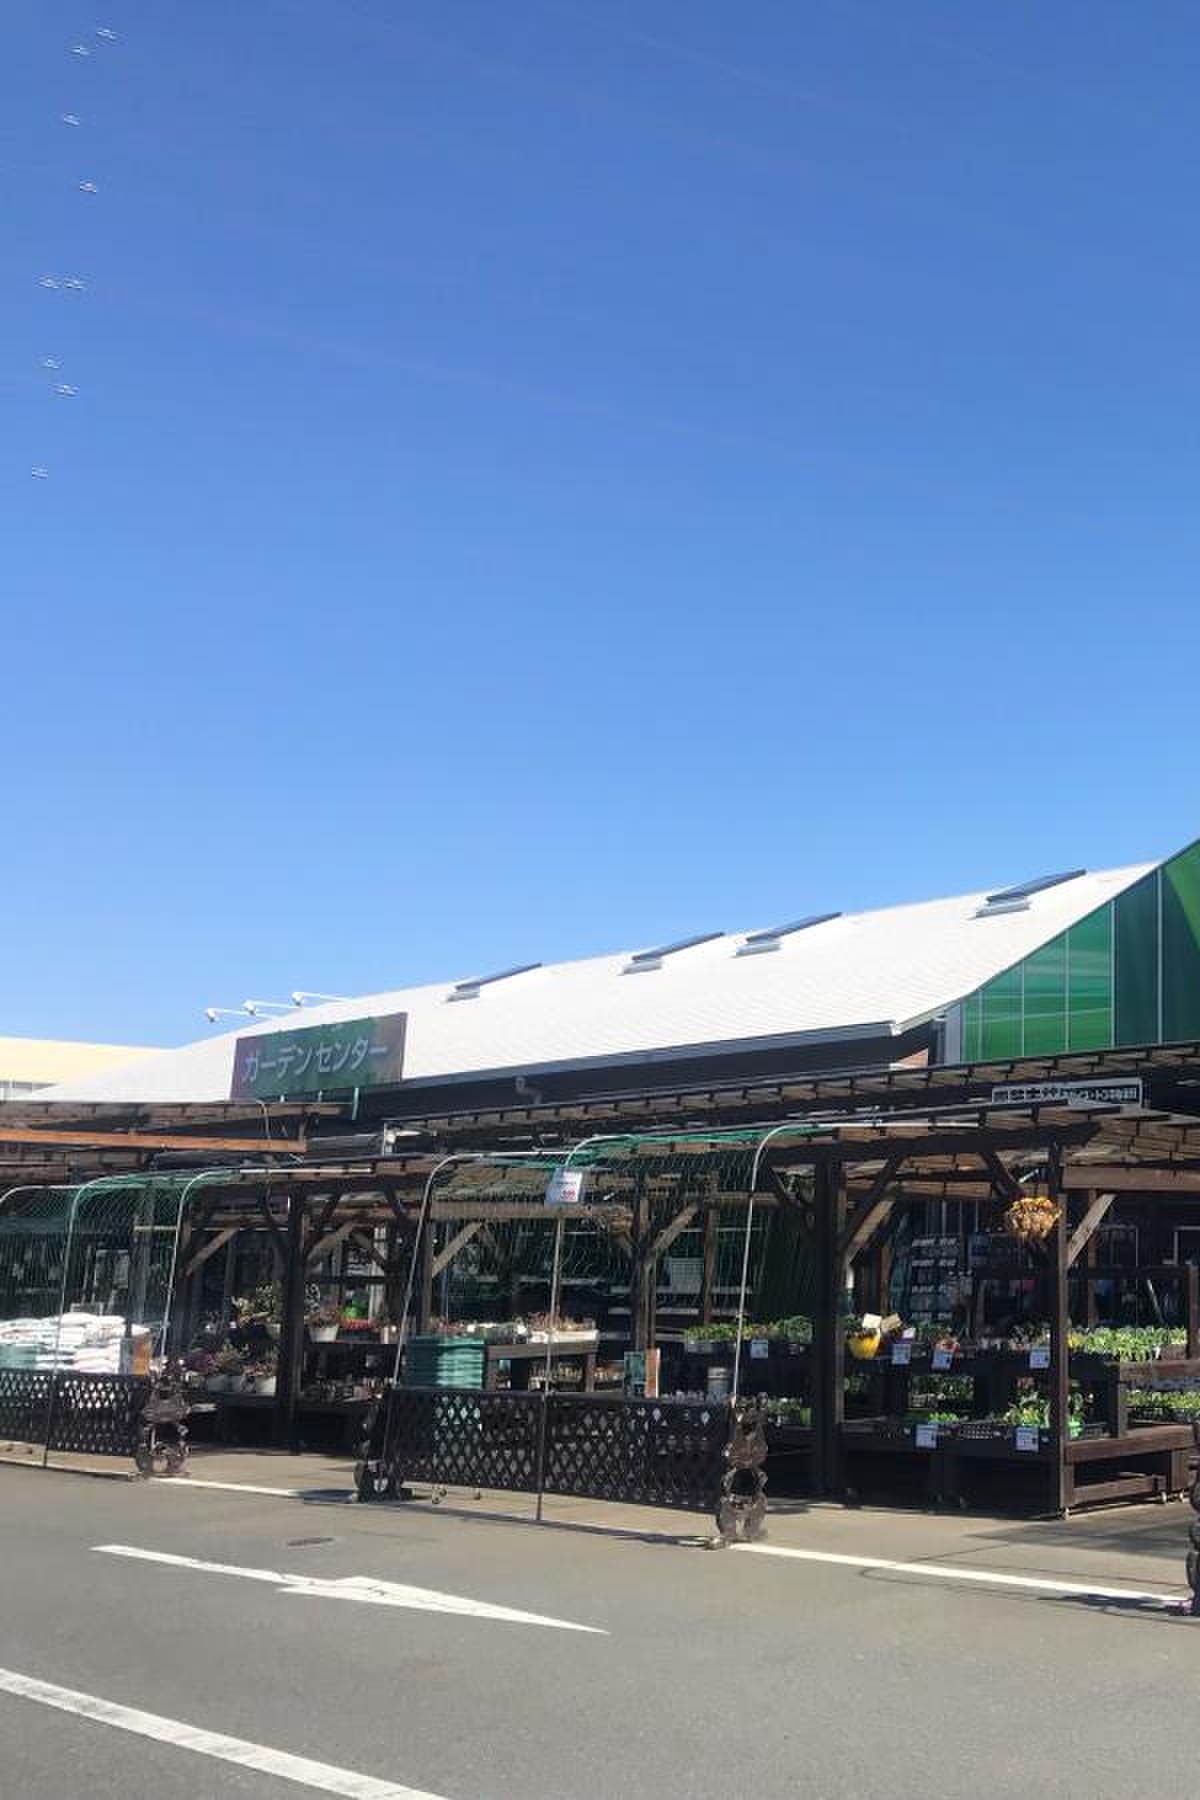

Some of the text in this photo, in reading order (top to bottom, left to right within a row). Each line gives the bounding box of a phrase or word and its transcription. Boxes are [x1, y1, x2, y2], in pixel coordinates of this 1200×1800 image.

[242, 1037, 387, 1081] ガーデンセンター
